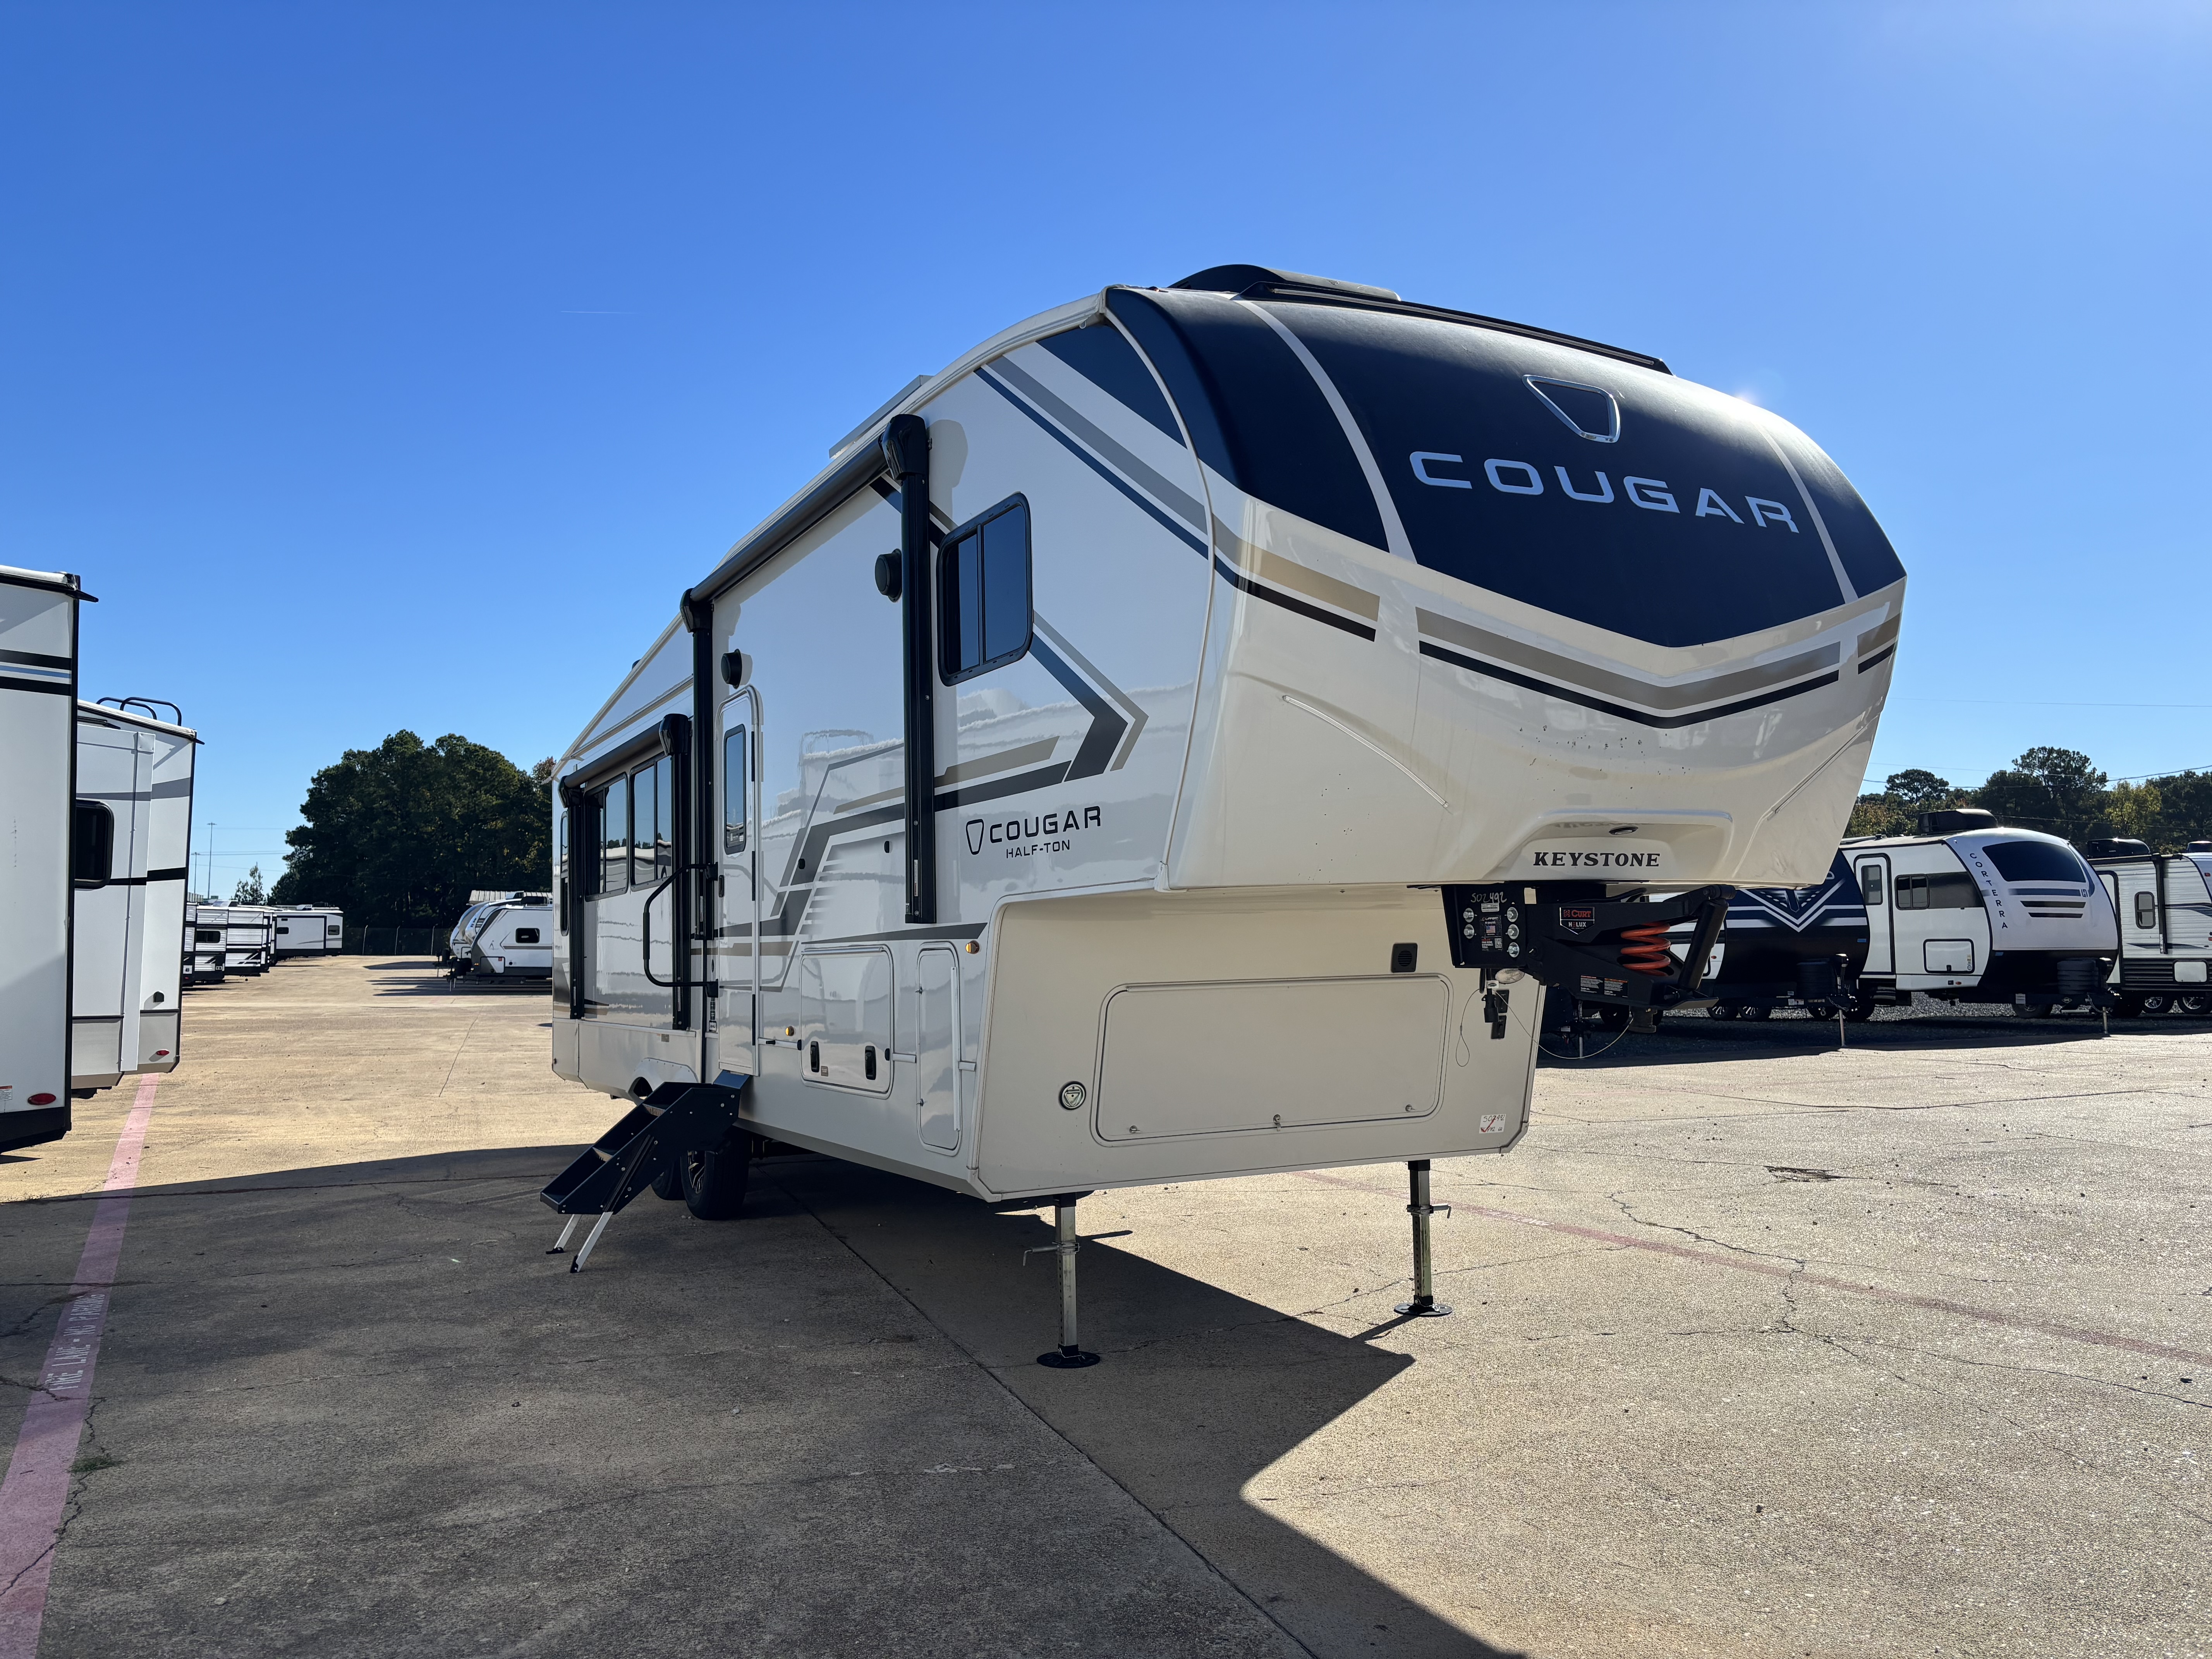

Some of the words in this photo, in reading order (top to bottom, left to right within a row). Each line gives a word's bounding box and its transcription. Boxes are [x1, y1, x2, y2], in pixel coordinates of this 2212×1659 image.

[1410, 451, 1799, 533] COUGAR
[990, 806, 1101, 843] COUGAR
[1006, 840, 1070, 858] HALF-TON
[1533, 852, 1660, 866] KEYSTONE
[1970, 853, 2008, 929] CORTERRA
[52, 1345, 91, 1366] LANE
